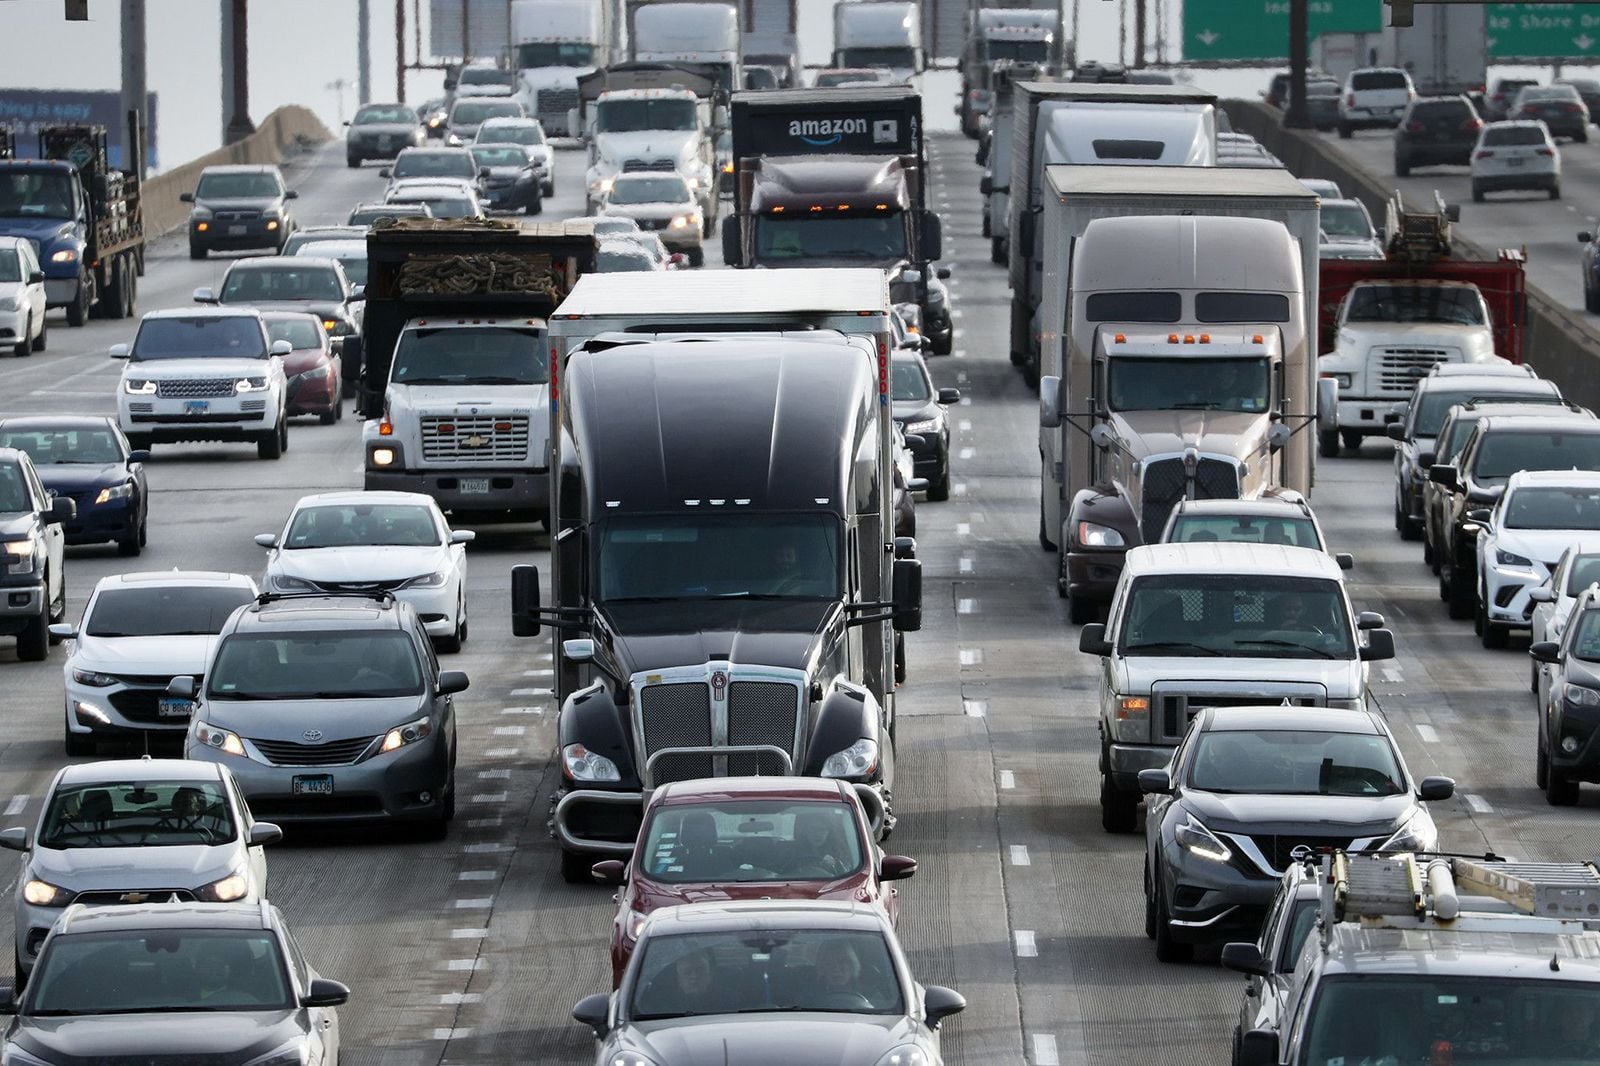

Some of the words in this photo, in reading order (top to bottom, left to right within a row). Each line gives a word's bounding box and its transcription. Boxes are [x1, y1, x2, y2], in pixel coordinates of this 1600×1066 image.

[1520, 14, 1572, 29] Shore
[53, 104, 92, 119] easy
[788, 118, 867, 136] amazon
